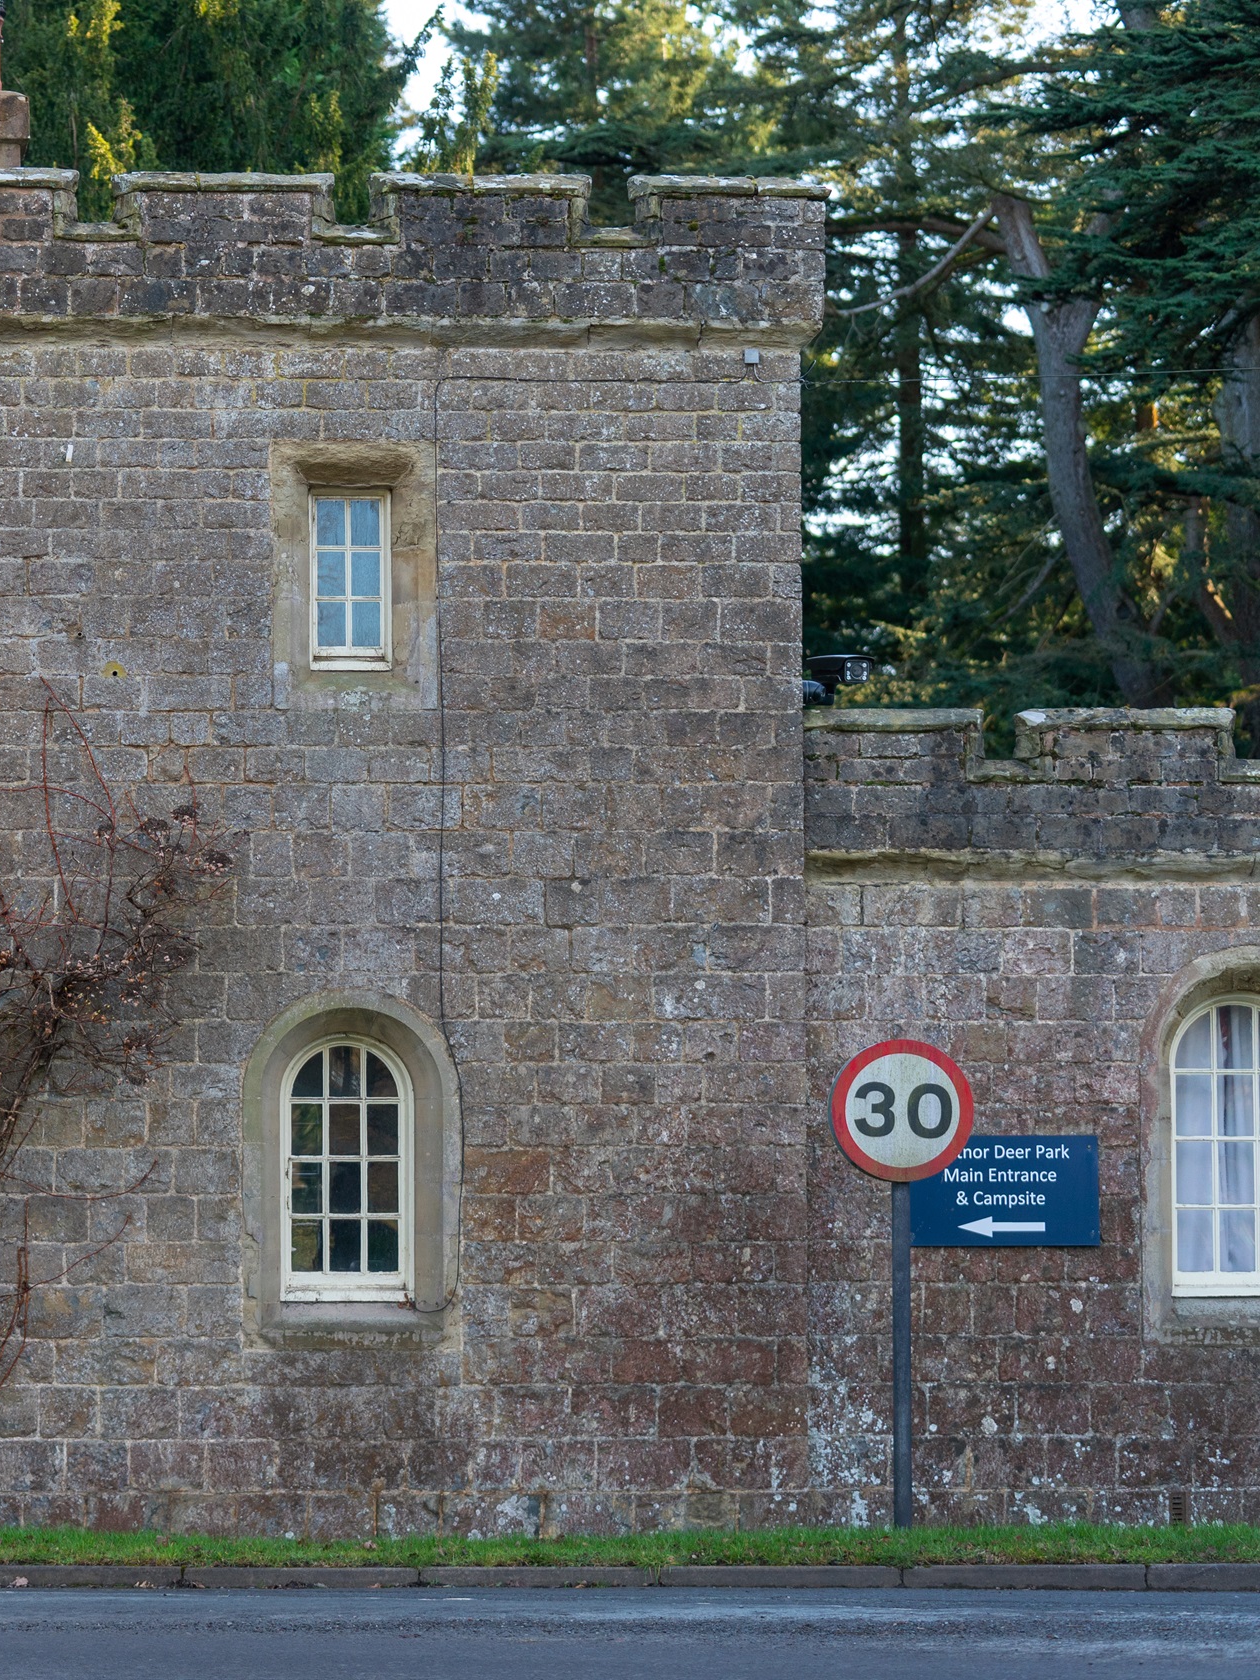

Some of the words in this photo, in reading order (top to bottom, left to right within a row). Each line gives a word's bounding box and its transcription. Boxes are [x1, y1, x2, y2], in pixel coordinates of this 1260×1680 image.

[853, 1081, 953, 1139] 30
[994, 1144, 1032, 1160] Deer
[1035, 1143, 1070, 1159] Park
[944, 1168, 983, 1183] Main
[988, 1168, 1057, 1183] Entrance
[956, 1191, 969, 1206] &
[973, 1191, 1046, 1209] Campsite
